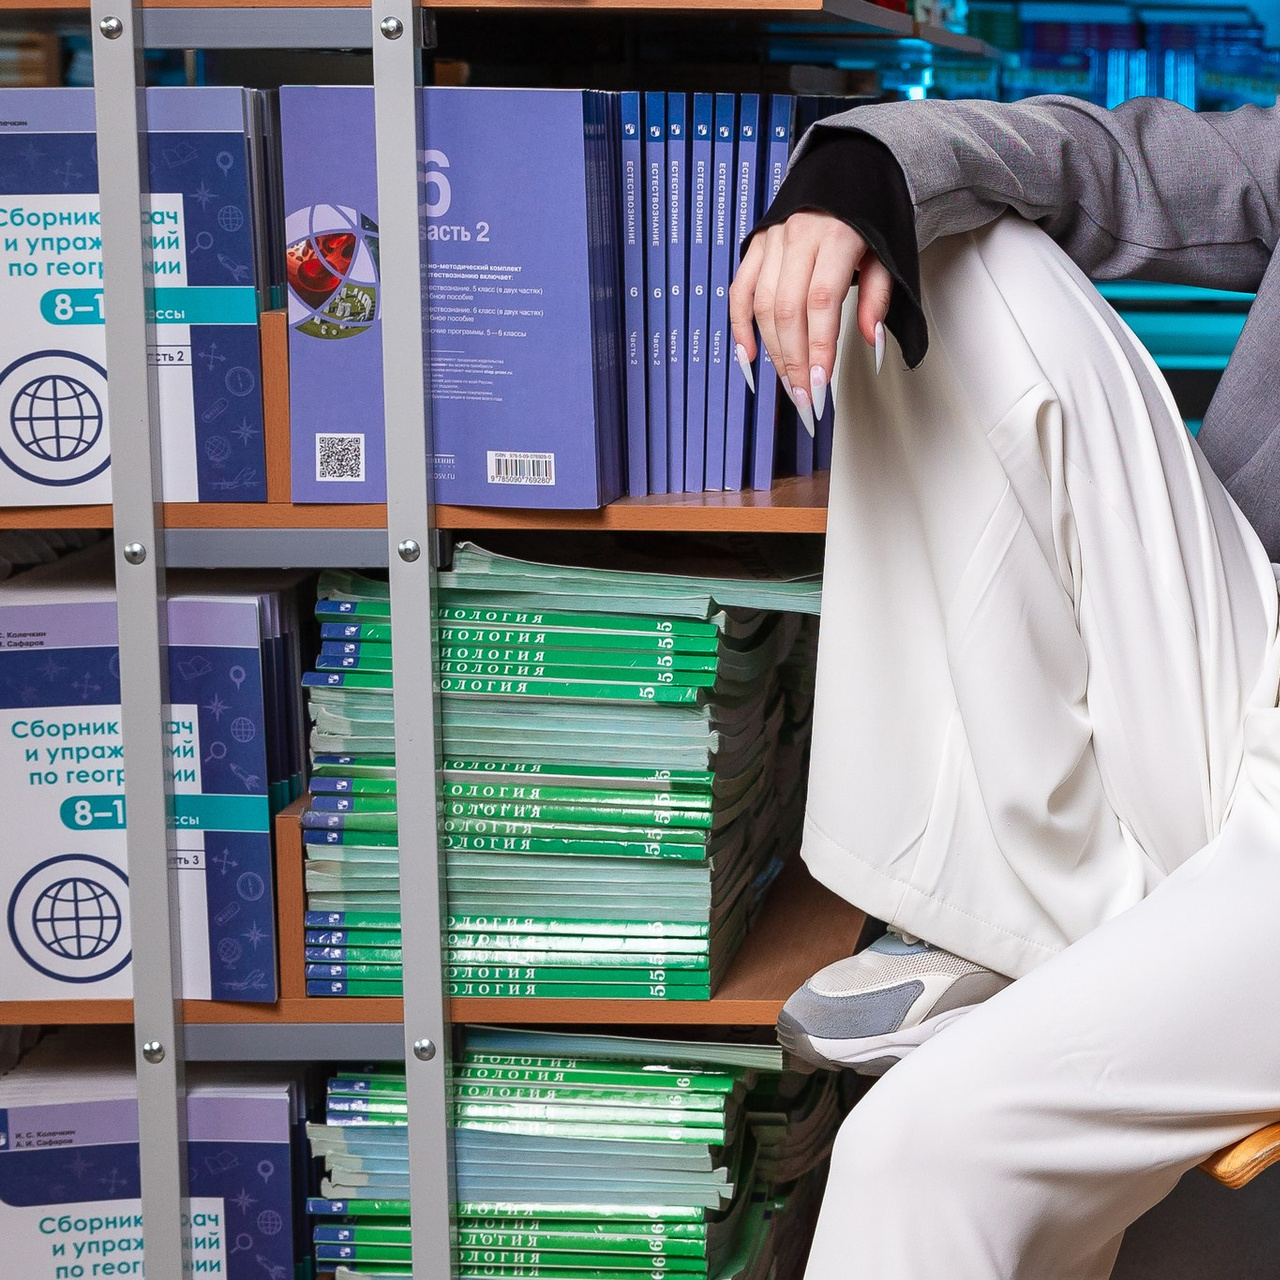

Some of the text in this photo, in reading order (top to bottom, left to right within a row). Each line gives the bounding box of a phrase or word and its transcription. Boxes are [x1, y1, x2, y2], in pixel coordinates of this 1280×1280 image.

[627, 161, 635, 245] ЕСТЕСТВОЗНАНИЕ
[651, 162, 660, 247] ЕСТЕСТВОЗНАНИЕ
[696, 161, 704, 244] ЕСТЕСТВОЗНАНИЕ
[716, 162, 726, 245] ЕСТЕСТВОЗНАНИЕ
[427, 221, 490, 242] асть 2
[4, 237, 18, 251] и
[8, 262, 38, 276] по
[489, 265, 522, 273] комплект
[630, 287, 638, 298] 6
[671, 285, 680, 296] 6
[503, 330, 527, 338] классы
[498, 476, 550, 484] 785090 769280
[438, 608, 673, 632] ИОЛОГИЯ 5
[441, 629, 674, 648] ИОЛОГИЯ 5
[441, 648, 545, 662] ИОЛОГИЯ
[11, 720, 119, 740] Сборник
[25, 749, 38, 762] и
[29, 772, 58, 785] по
[74, 799, 125, 826] 8–1
[650, 986, 666, 996] 5
[461, 1069, 690, 1087] ИОЛОГИЯ 6
[38, 1214, 143, 1235] Сборник
[52, 1243, 65, 1256] и
[56, 1264, 84, 1279] по
